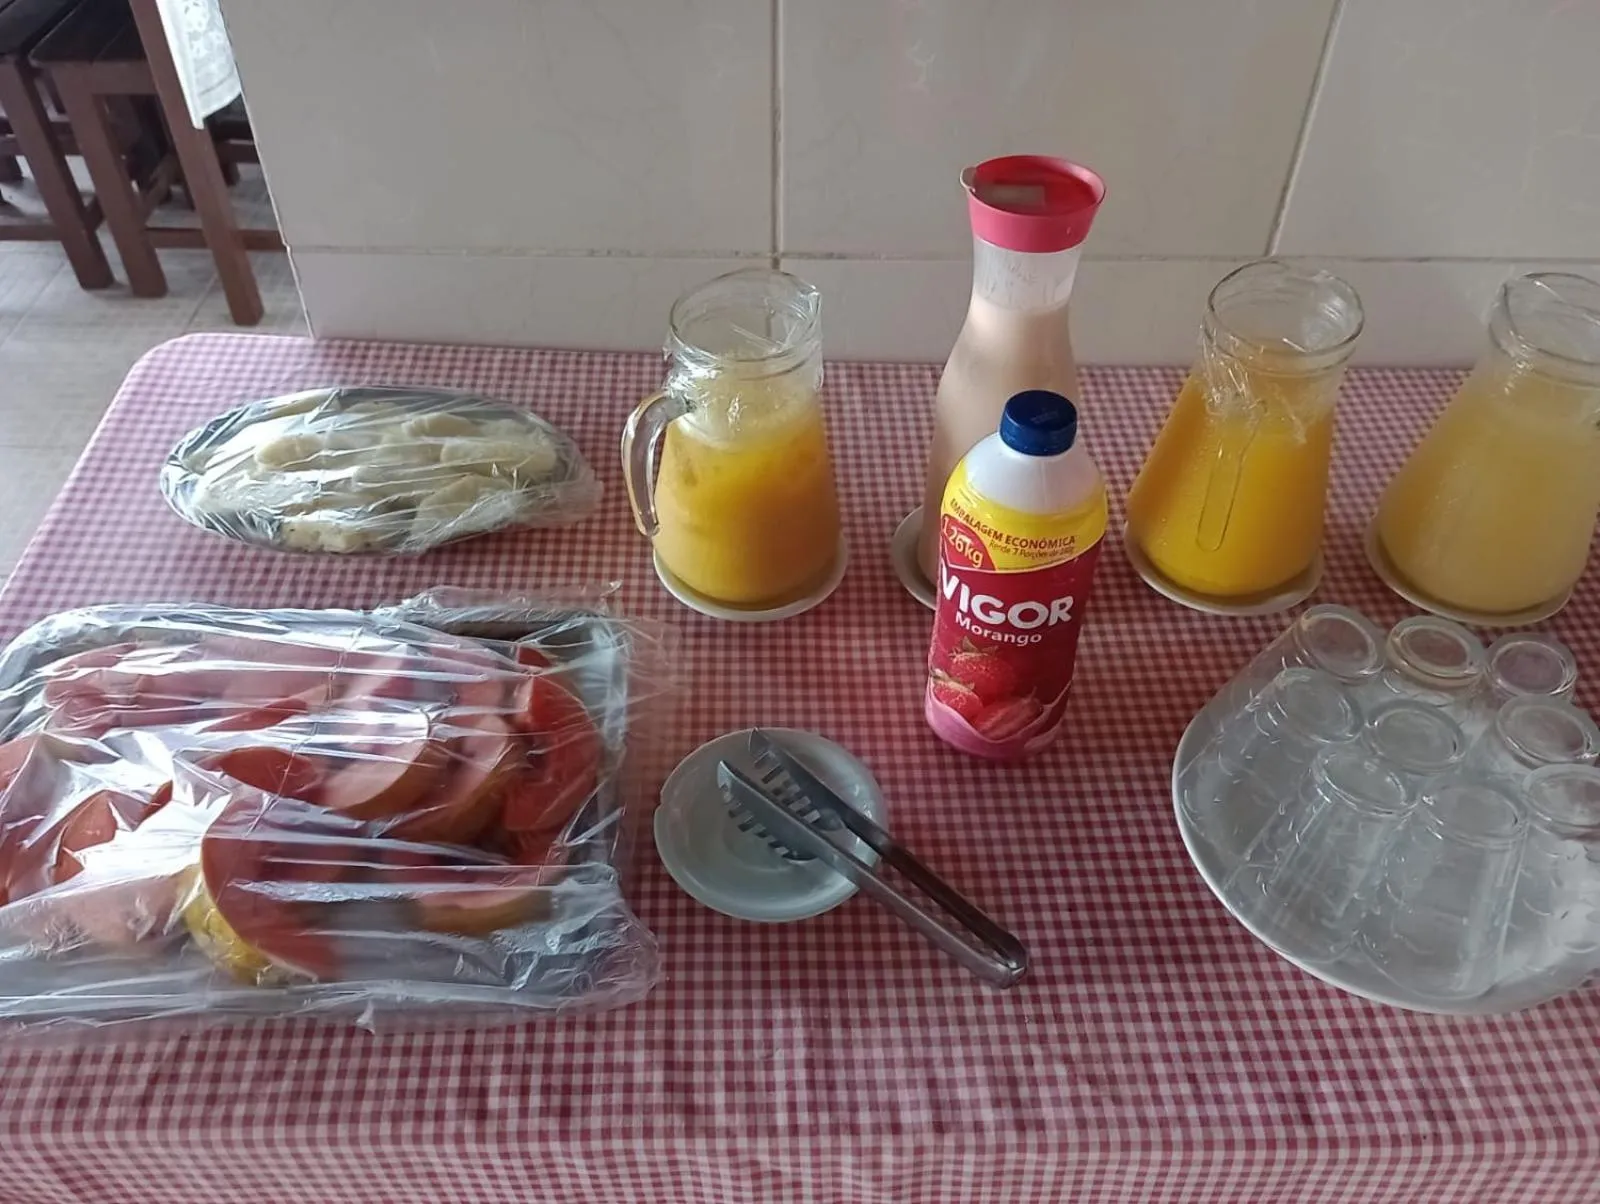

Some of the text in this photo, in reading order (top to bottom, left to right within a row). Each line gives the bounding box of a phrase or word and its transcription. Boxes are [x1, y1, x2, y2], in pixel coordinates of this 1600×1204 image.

[950, 498, 1003, 542] EMBALAGEM
[940, 558, 1074, 630] VIGOR
[955, 612, 1042, 647] Morango
